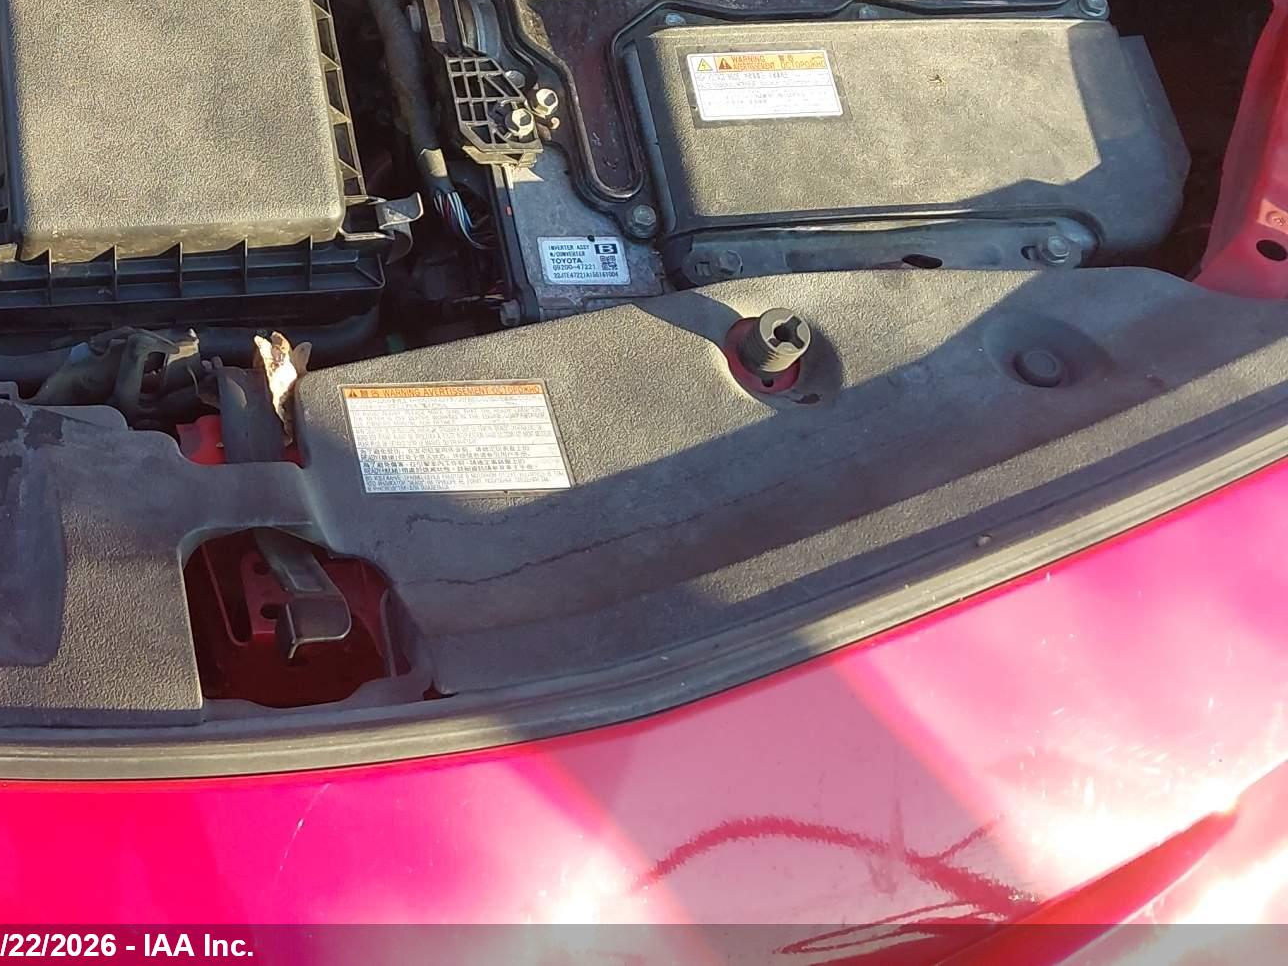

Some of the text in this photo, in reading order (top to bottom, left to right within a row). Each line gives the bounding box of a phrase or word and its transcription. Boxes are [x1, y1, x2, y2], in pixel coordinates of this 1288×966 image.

[599, 244, 614, 254] B
[383, 387, 492, 398] WARNING AVERTISSEMENT
